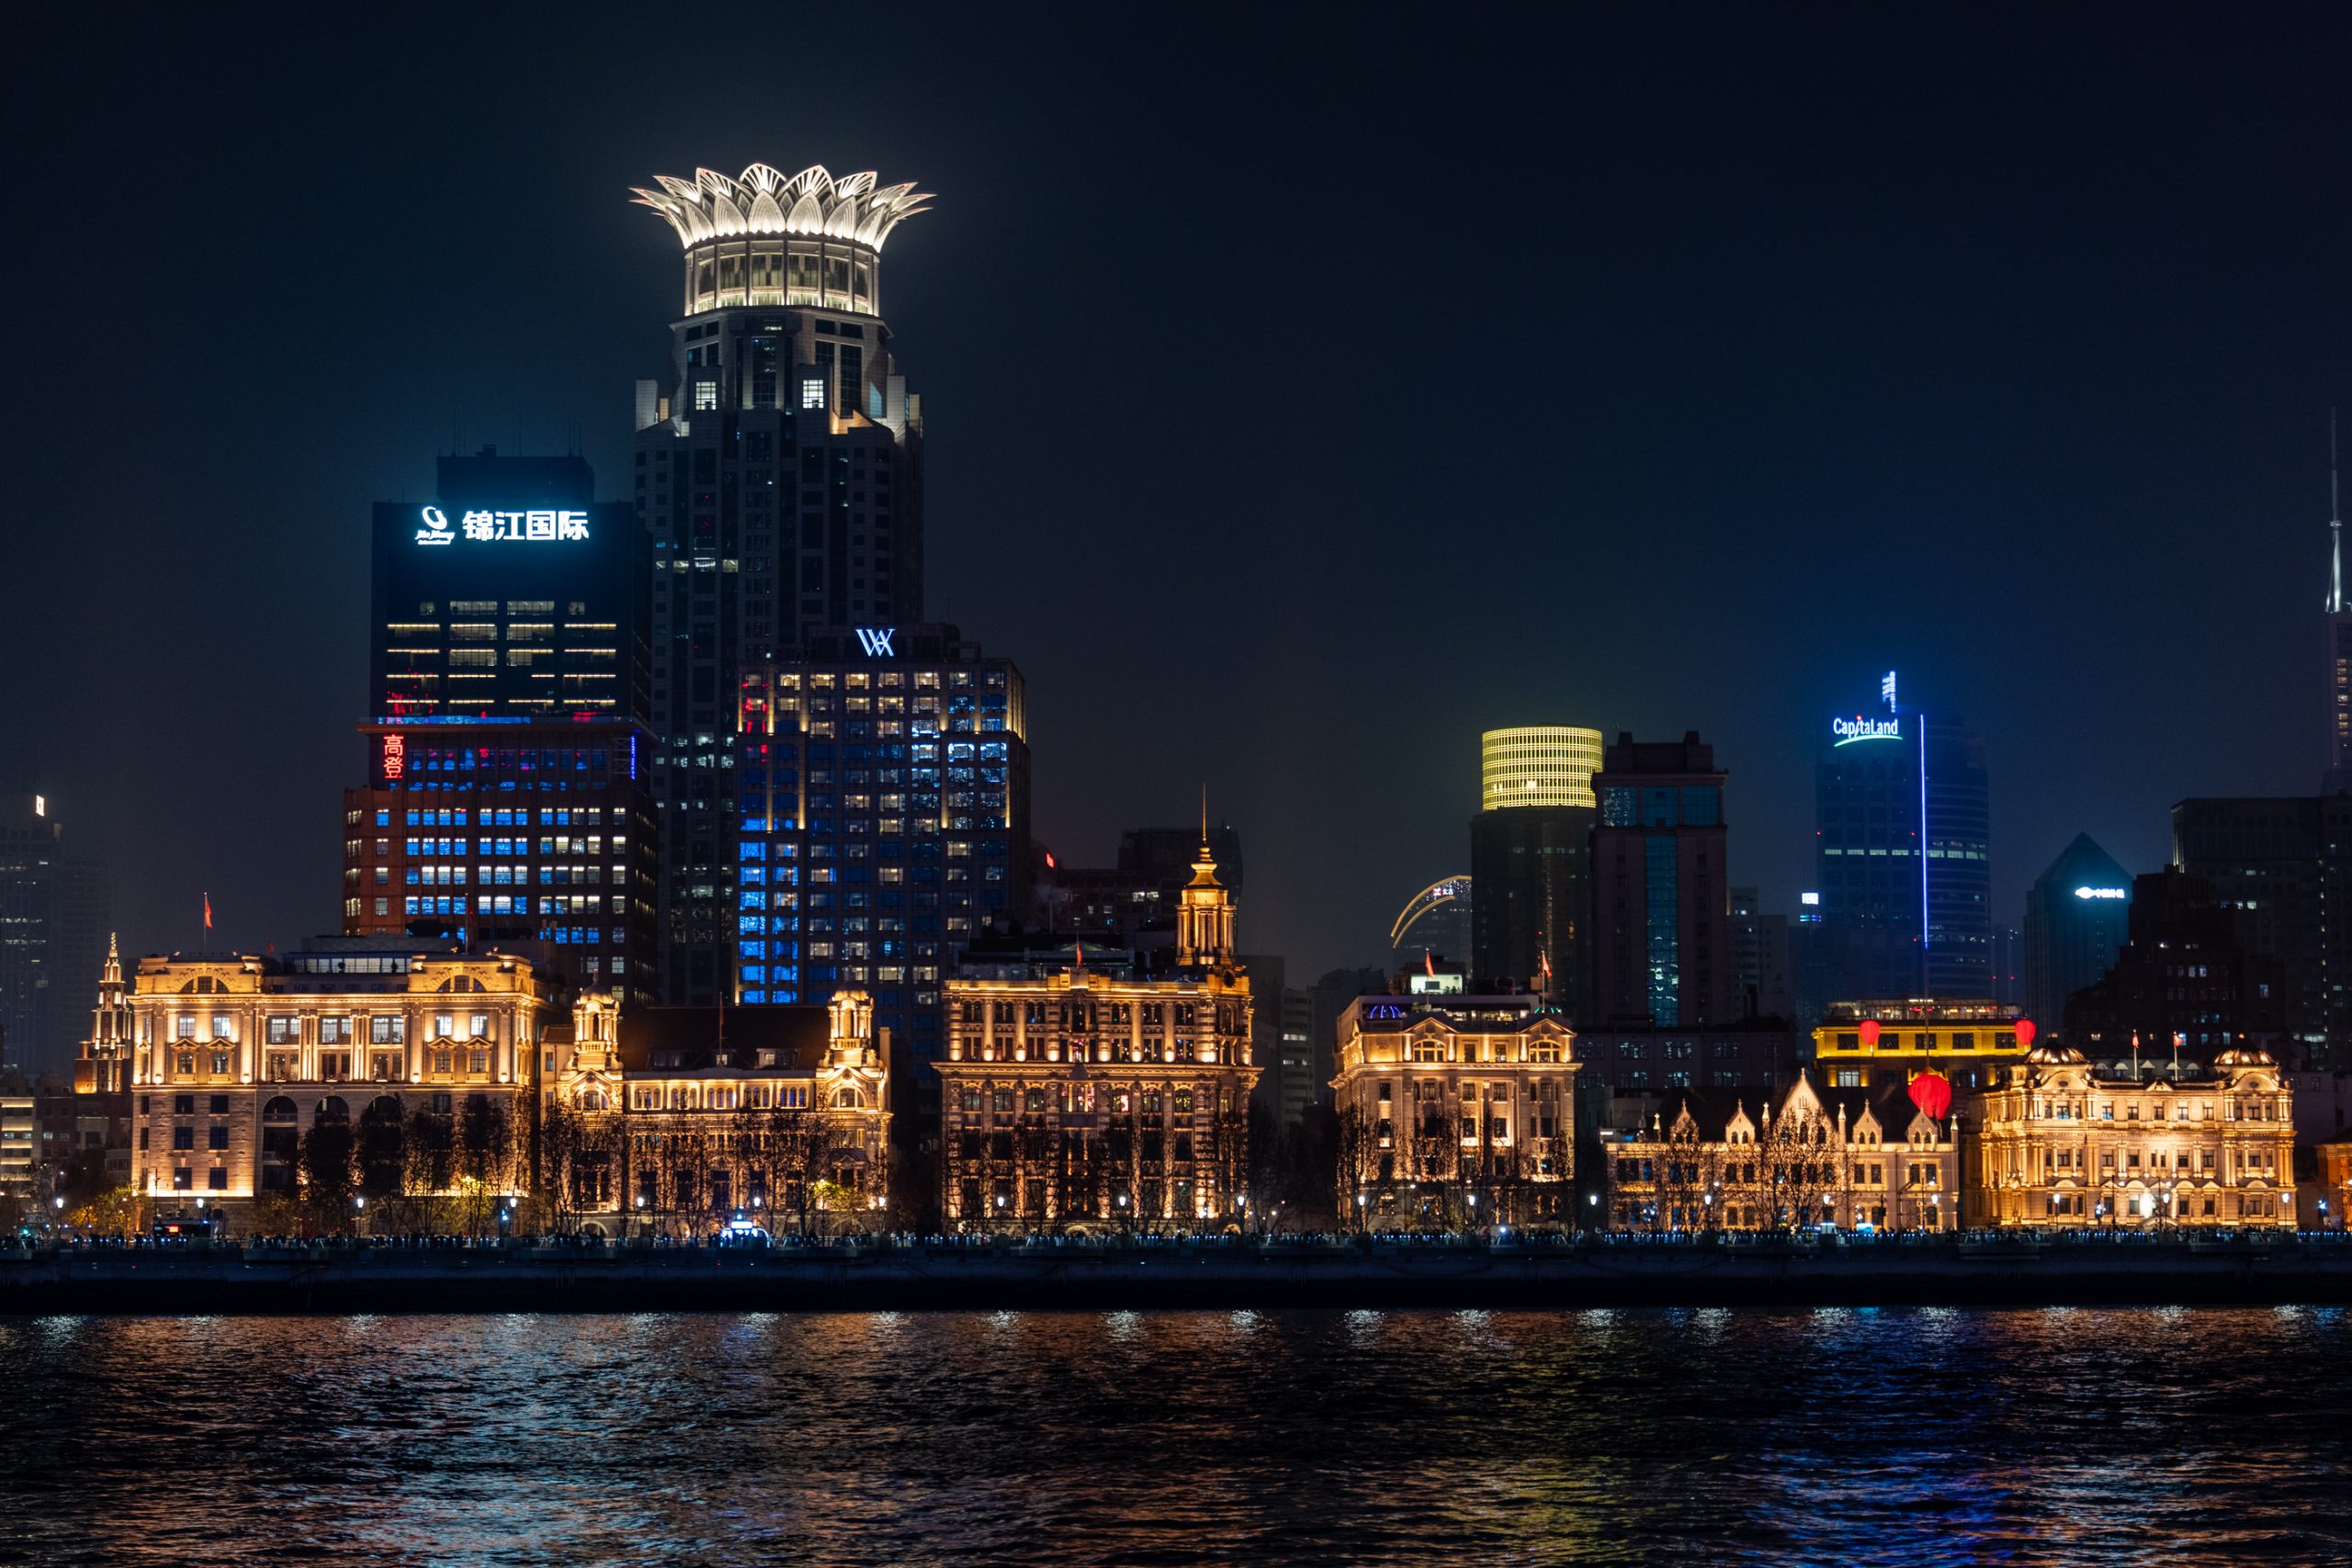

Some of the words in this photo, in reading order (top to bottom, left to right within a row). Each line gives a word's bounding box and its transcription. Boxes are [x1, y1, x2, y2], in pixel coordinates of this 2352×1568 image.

[462, 511, 589, 541] 锦江国际
[1833, 715, 1899, 739] CapitaLand
[383, 734, 404, 779] 高登
